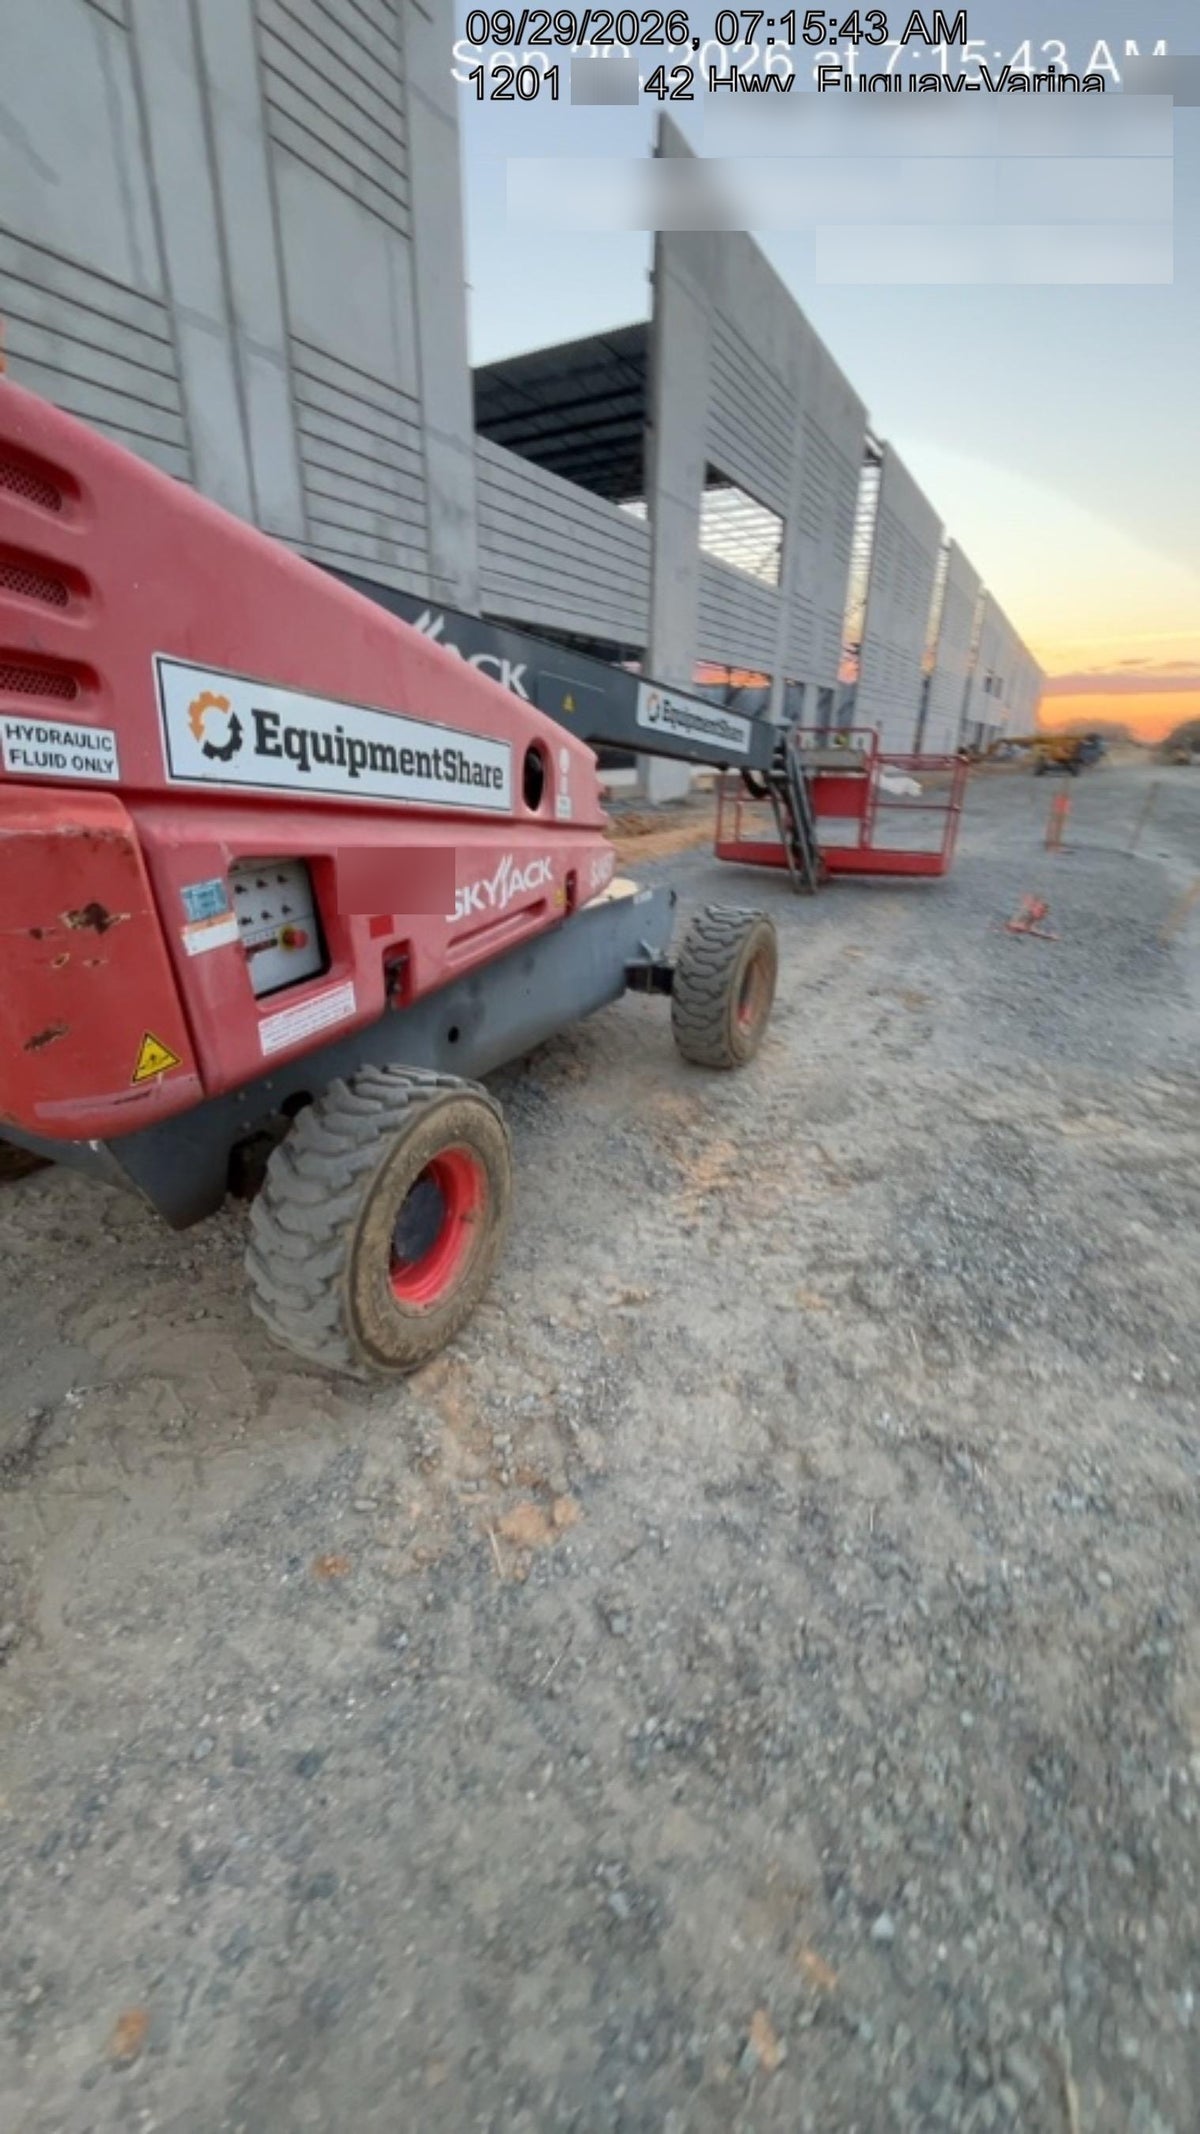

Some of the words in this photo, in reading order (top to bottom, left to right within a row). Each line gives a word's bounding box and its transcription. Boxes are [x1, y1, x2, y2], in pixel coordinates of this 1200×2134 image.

[5, 723, 112, 751] HYDRAULIC
[9, 749, 67, 769] FLUID
[71, 755, 114, 773] ONLY
[251, 708, 503, 789] EquipmentShare
[445, 853, 554, 923] SKYJACK
